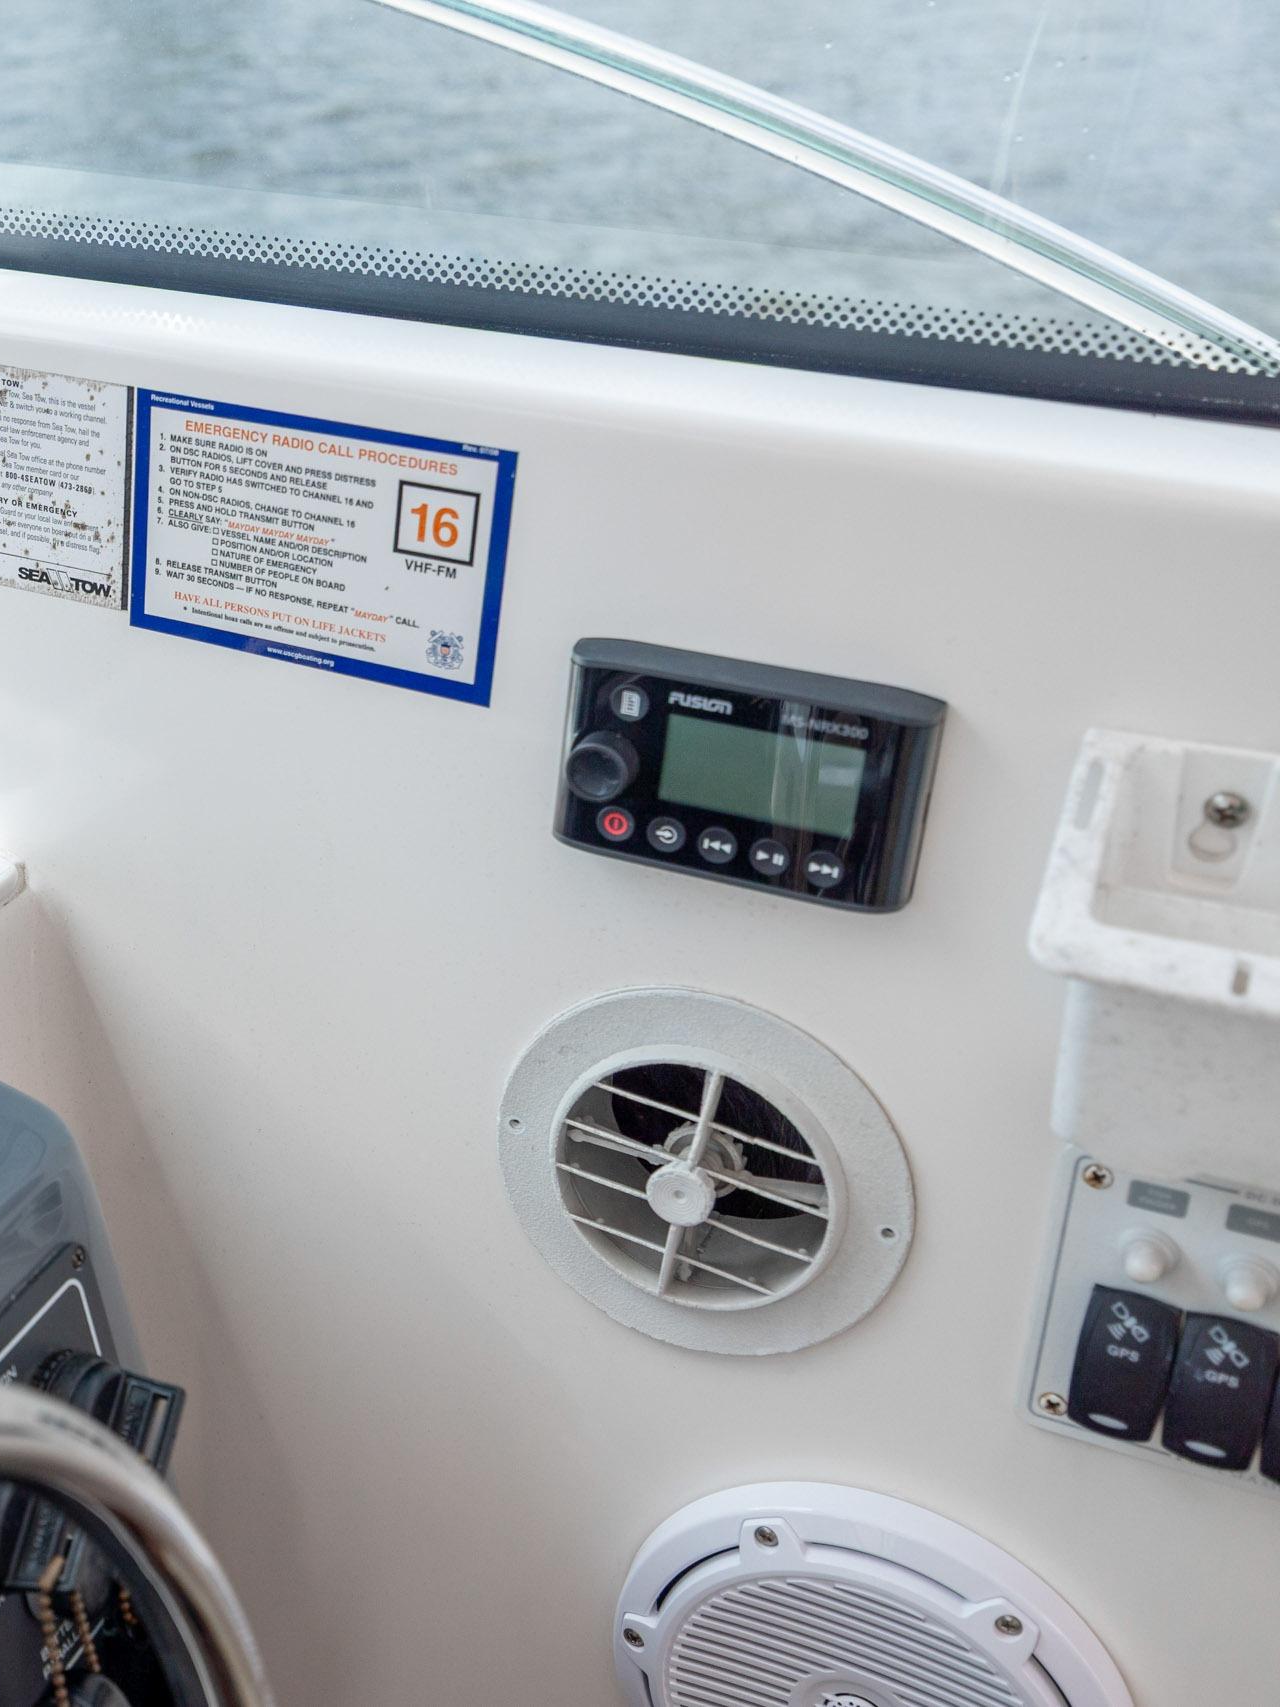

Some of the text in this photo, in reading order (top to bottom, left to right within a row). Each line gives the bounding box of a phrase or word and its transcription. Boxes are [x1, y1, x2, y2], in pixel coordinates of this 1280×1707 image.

[169, 433, 193, 445] MAKE
[194, 438, 217, 450] SURE
[218, 442, 244, 454] RADIO
[245, 447, 254, 456] IS
[255, 448, 268, 458] ON
[185, 419, 269, 444] EMERGENCY
[271, 433, 315, 452] RADIO
[318, 441, 354, 459] CALL
[358, 448, 458, 476] PROCEDURES
[169, 476, 223, 494] GO TO STEP 5
[11, 498, 23, 508] OR
[25, 501, 78, 518] EMERGENCY
[168, 497, 195, 510] PRESS
[195, 503, 214, 513] AND
[214, 506, 237, 518] HOLD
[238, 510, 280, 525] TRANSMIT
[281, 518, 315, 532] BUTTON
[410, 503, 460, 548] 16
[17, 566, 52, 586] SEA
[404, 558, 457, 580] VHF-FM
[174, 591, 386, 643] HAVE ALL PERSONS PUT ON LIFE JACKETS
[266, 646, 335, 668] www.uscgboating.org
[1107, 1344, 1140, 1364] GPS
[1204, 1369, 1240, 1389] GPS
